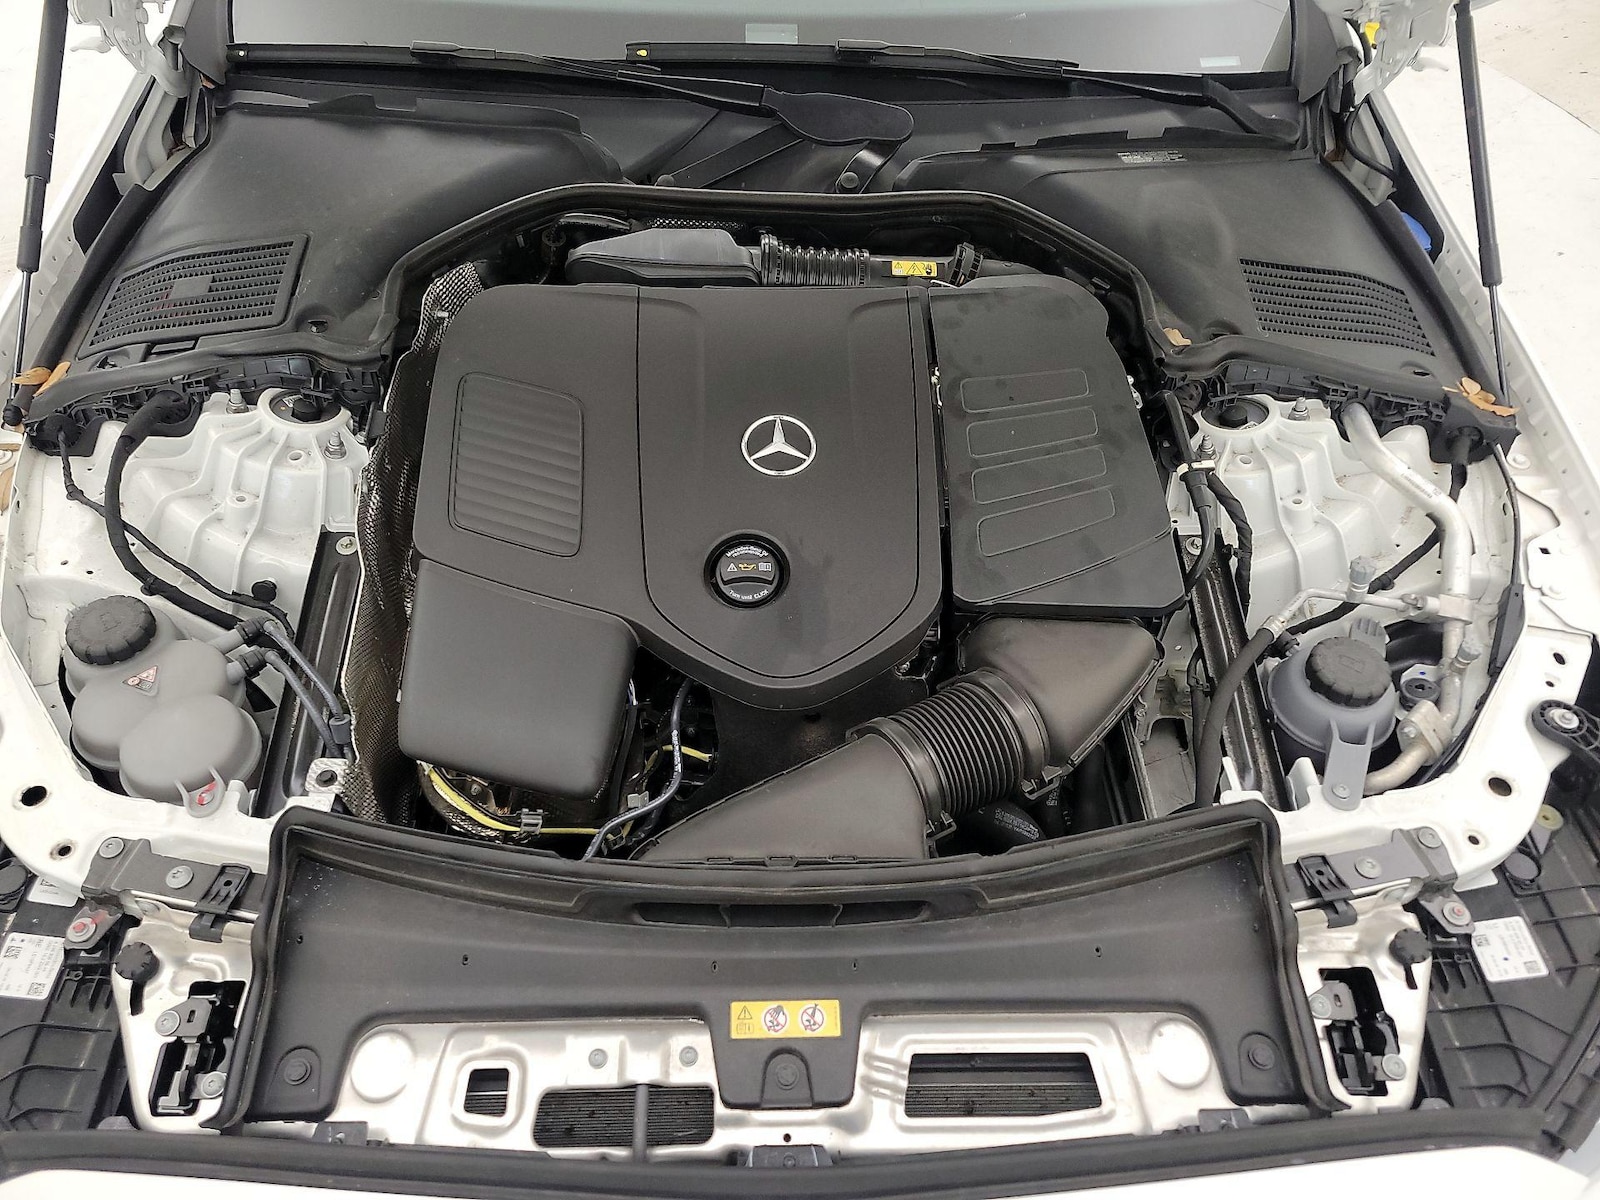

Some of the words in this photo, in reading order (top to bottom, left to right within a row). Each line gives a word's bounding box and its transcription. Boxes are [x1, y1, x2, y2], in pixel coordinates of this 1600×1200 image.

[725, 545, 762, 557] Mercedes-Benz
[729, 589, 741, 598] Turn
[753, 589, 769, 599] CLICK
